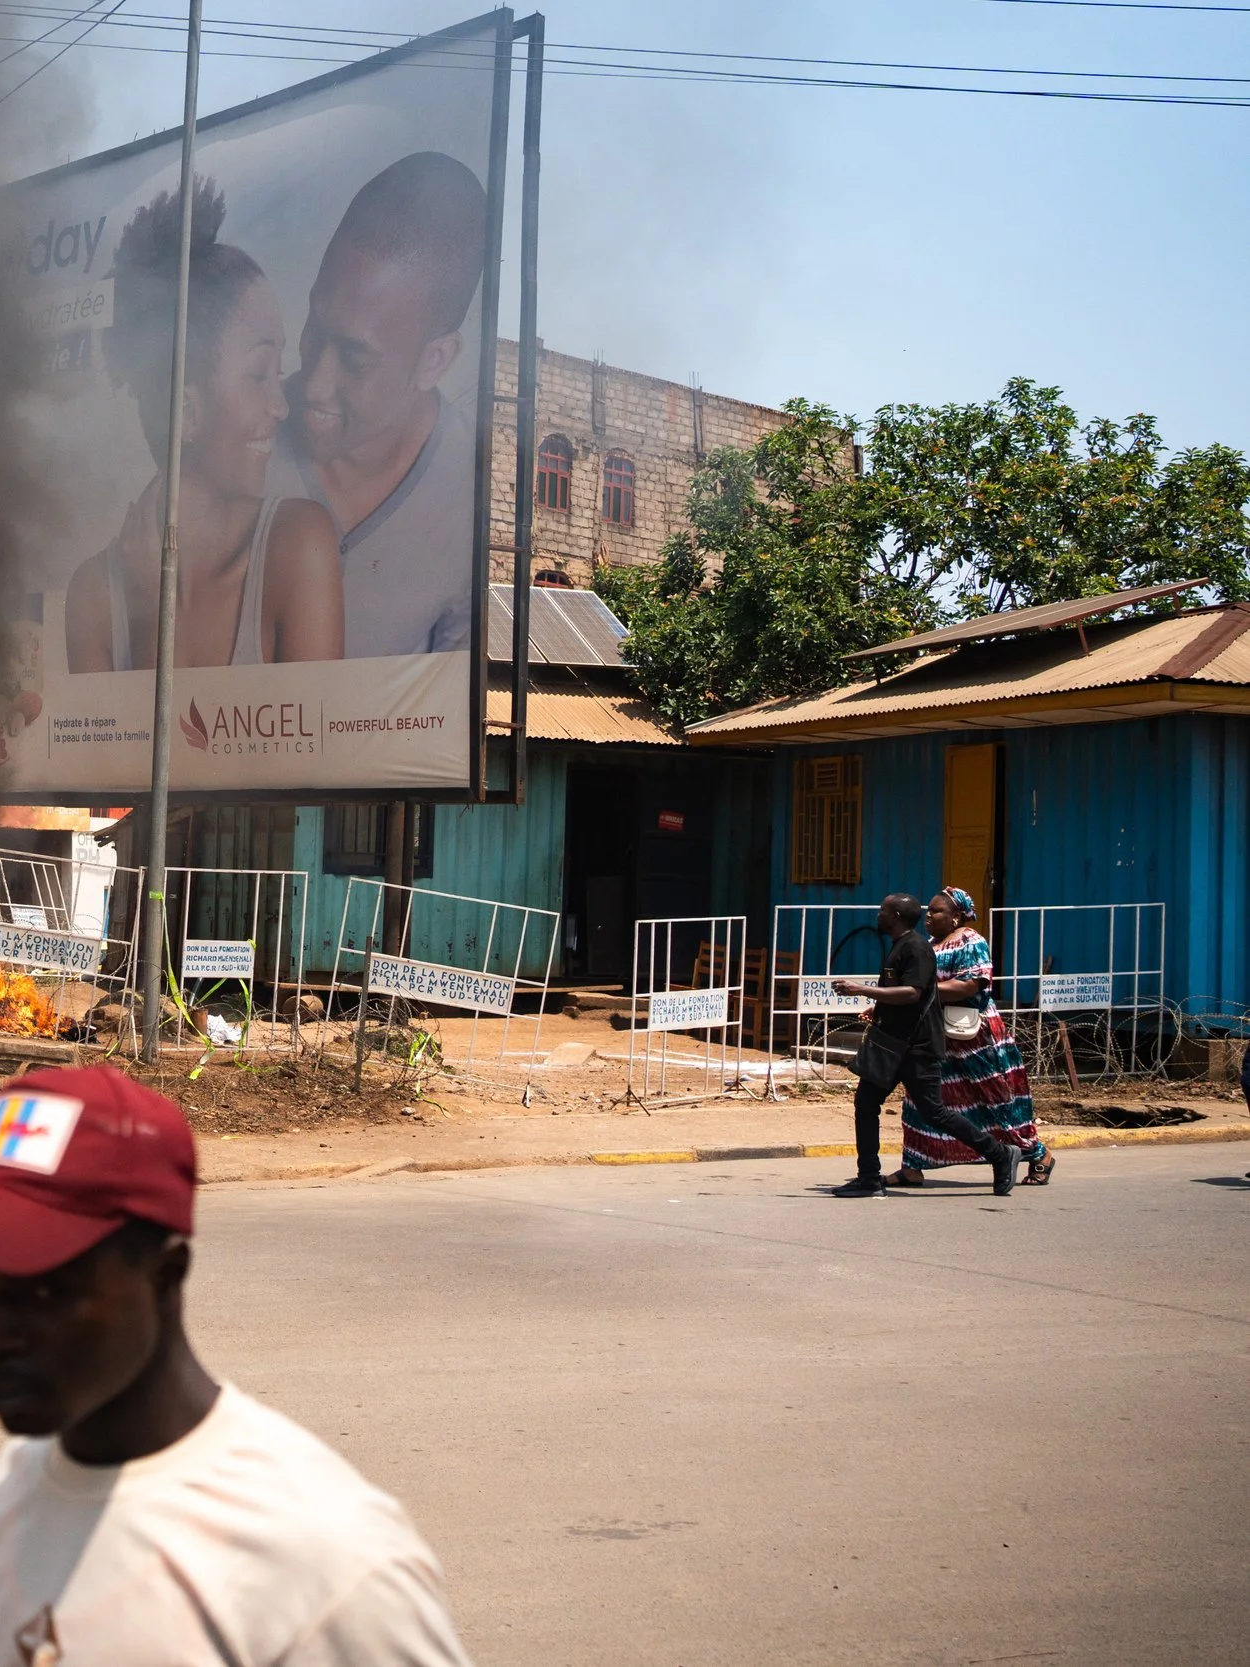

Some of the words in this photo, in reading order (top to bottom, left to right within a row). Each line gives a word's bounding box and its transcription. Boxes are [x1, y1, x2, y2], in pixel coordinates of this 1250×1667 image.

[53, 718, 81, 730] Hydrate
[84, 720, 90, 728] &
[92, 717, 116, 729] répare
[212, 704, 313, 738] ANGEL
[329, 718, 394, 734] POWERFUL
[396, 716, 445, 730] BEAUTY
[53, 733, 60, 743] la
[62, 735, 79, 744] peau
[82, 732, 91, 742] de
[93, 732, 113, 742] toute
[115, 731, 122, 742] la
[124, 730, 150, 742] famille
[212, 742, 314, 755] COSMETICS
[6, 933, 22, 942] LA
[27, 934, 94, 953] FONDATION
[14, 941, 93, 962] MWENYEMALI
[27, 952, 88, 970] SUD-KIVU
[373, 960, 398, 970] DON
[403, 966, 416, 975] DE
[422, 968, 436, 978] LA
[442, 971, 510, 991] FONDATION
[1077, 976, 1110, 985] FONDATION
[372, 969, 423, 984] RICHARD
[429, 979, 509, 1000] MWENYEMALI
[385, 979, 401, 988] LA
[409, 984, 433, 994] PCR
[442, 990, 505, 1007] SUD-KIVU
[653, 999, 667, 1007] DON
[689, 994, 724, 1004] FONDATION
[1076, 995, 1110, 1003] SUD-KIVU
[652, 1006, 679, 1015] RICHARD
[682, 1002, 724, 1013] MWENYEMALI
[672, 1014, 685, 1022] PCR
[690, 1011, 722, 1021] SUD-KIVU
